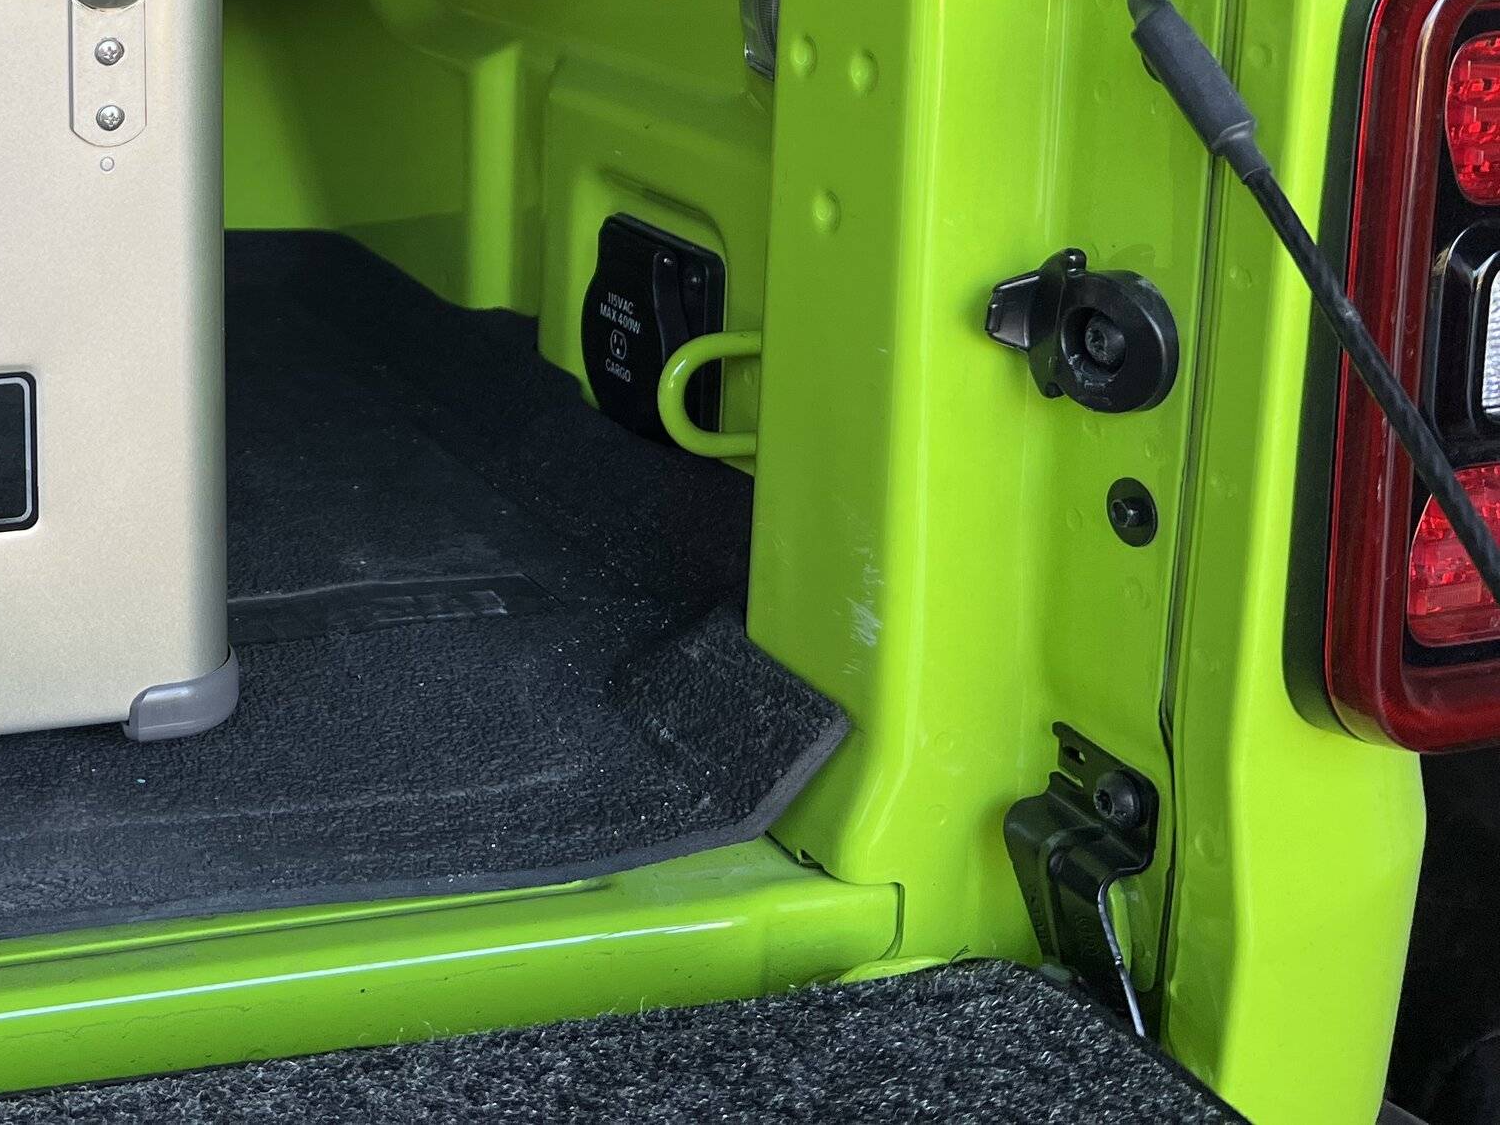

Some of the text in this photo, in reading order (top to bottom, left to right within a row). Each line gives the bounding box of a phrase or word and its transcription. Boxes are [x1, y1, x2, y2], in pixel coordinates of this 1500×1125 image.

[600, 302, 617, 323] MAX
[607, 291, 634, 315] 115VAC
[605, 358, 631, 383] CARGO
